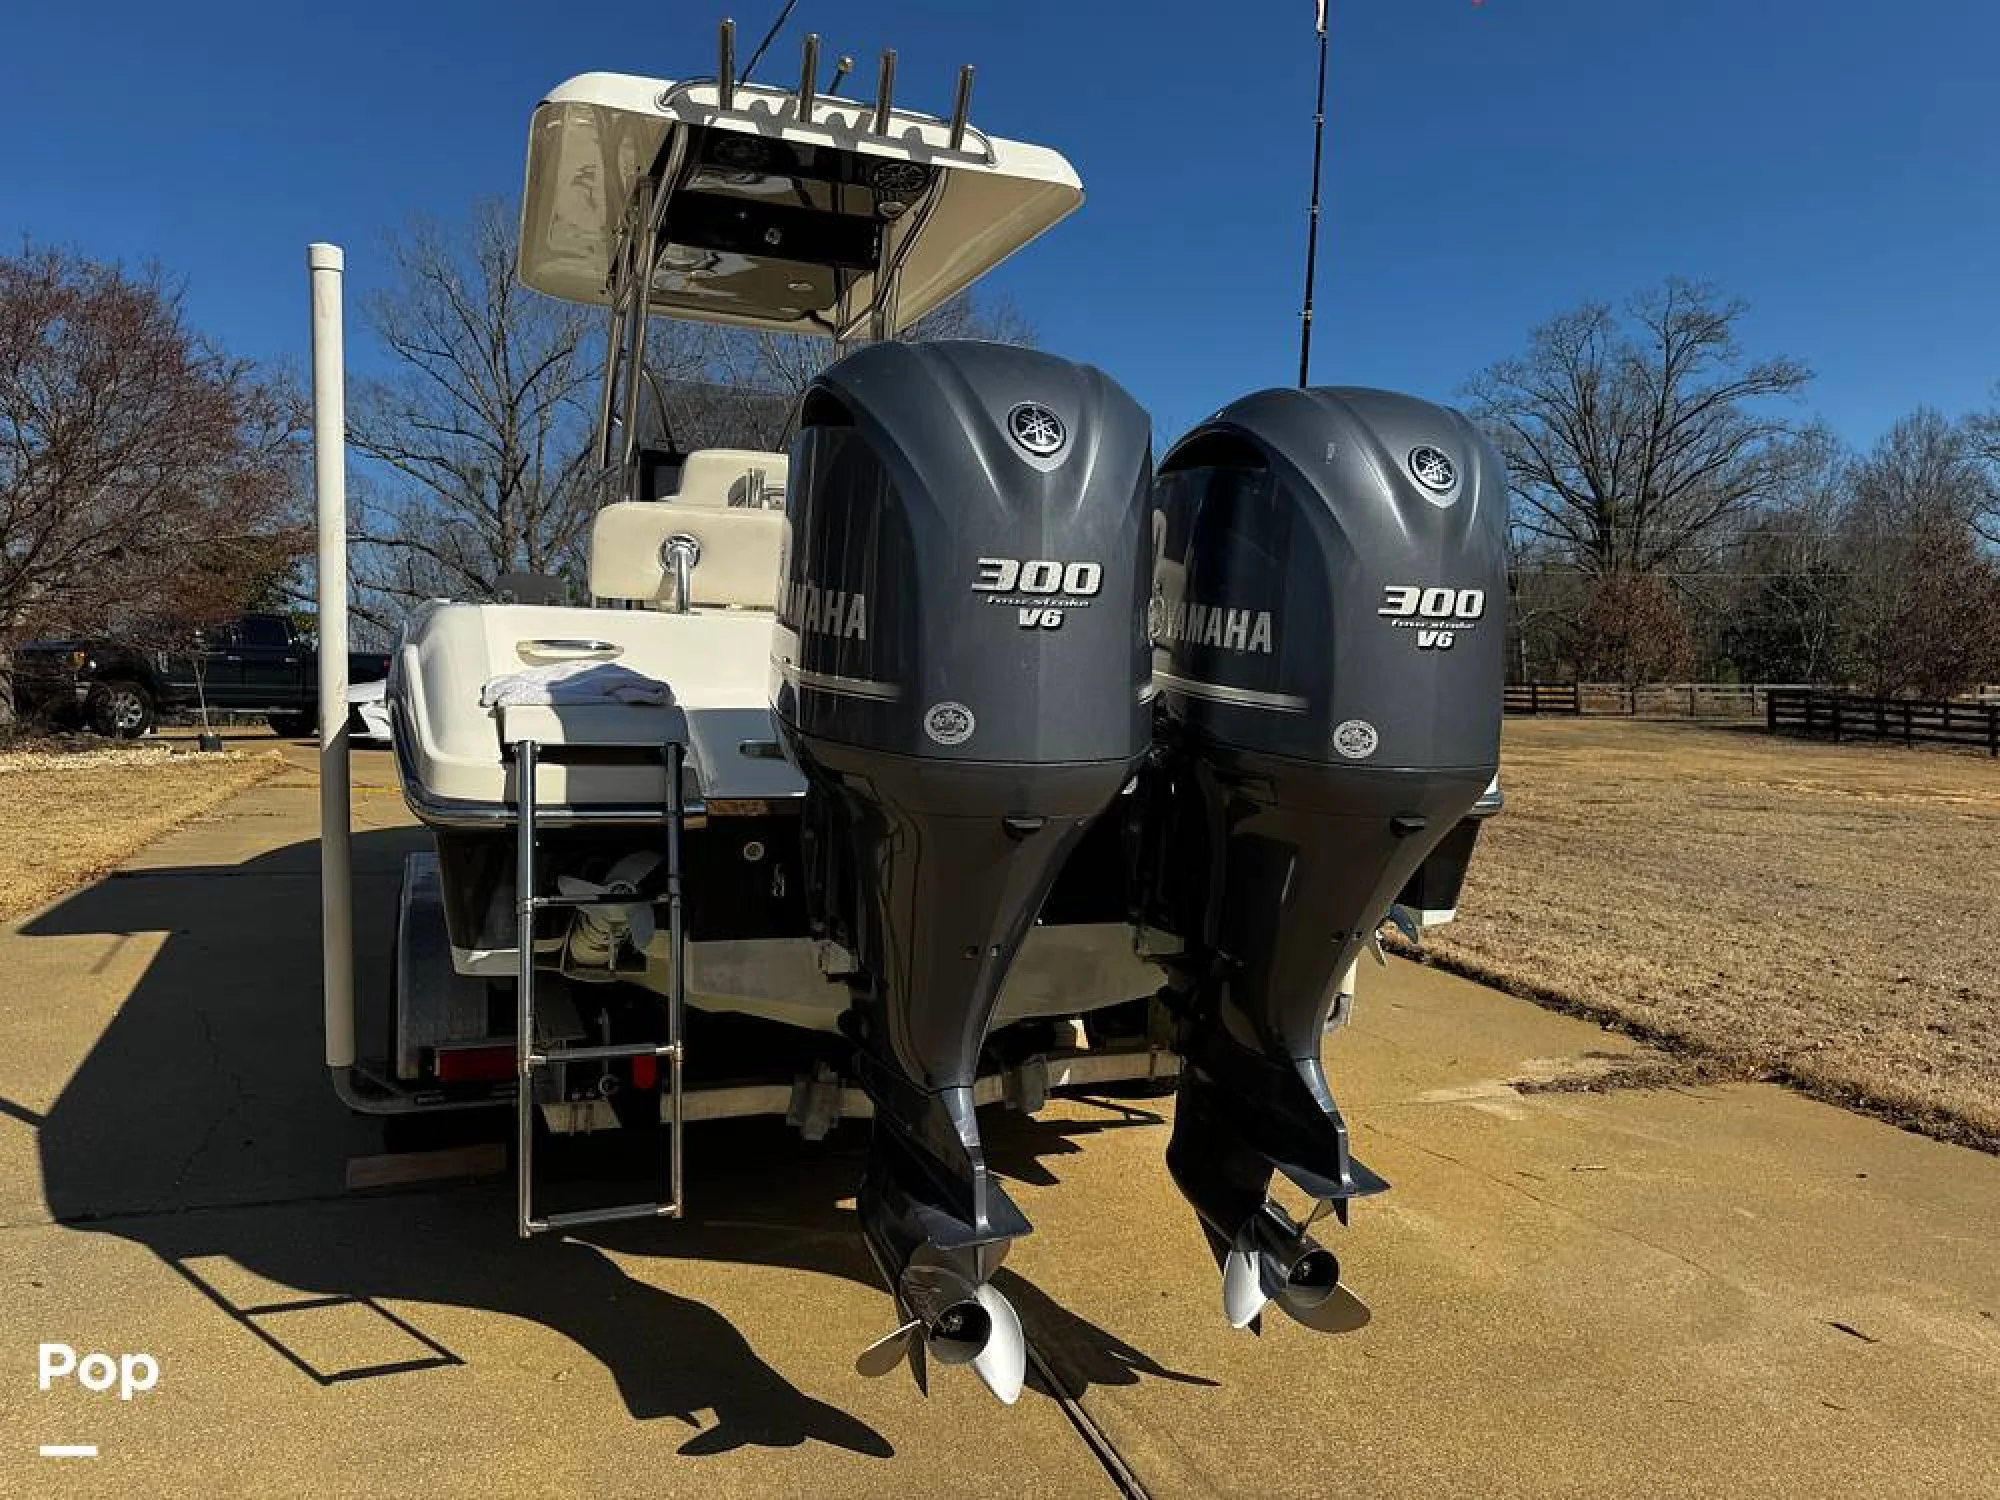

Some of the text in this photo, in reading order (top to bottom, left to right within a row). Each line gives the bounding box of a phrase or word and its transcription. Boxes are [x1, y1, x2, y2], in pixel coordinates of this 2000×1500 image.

[972, 557, 1102, 595] 300
[778, 577, 866, 640] MAHA
[1019, 607, 1064, 629] V6
[1378, 585, 1485, 619] 300
[1417, 629, 1455, 649] V6
